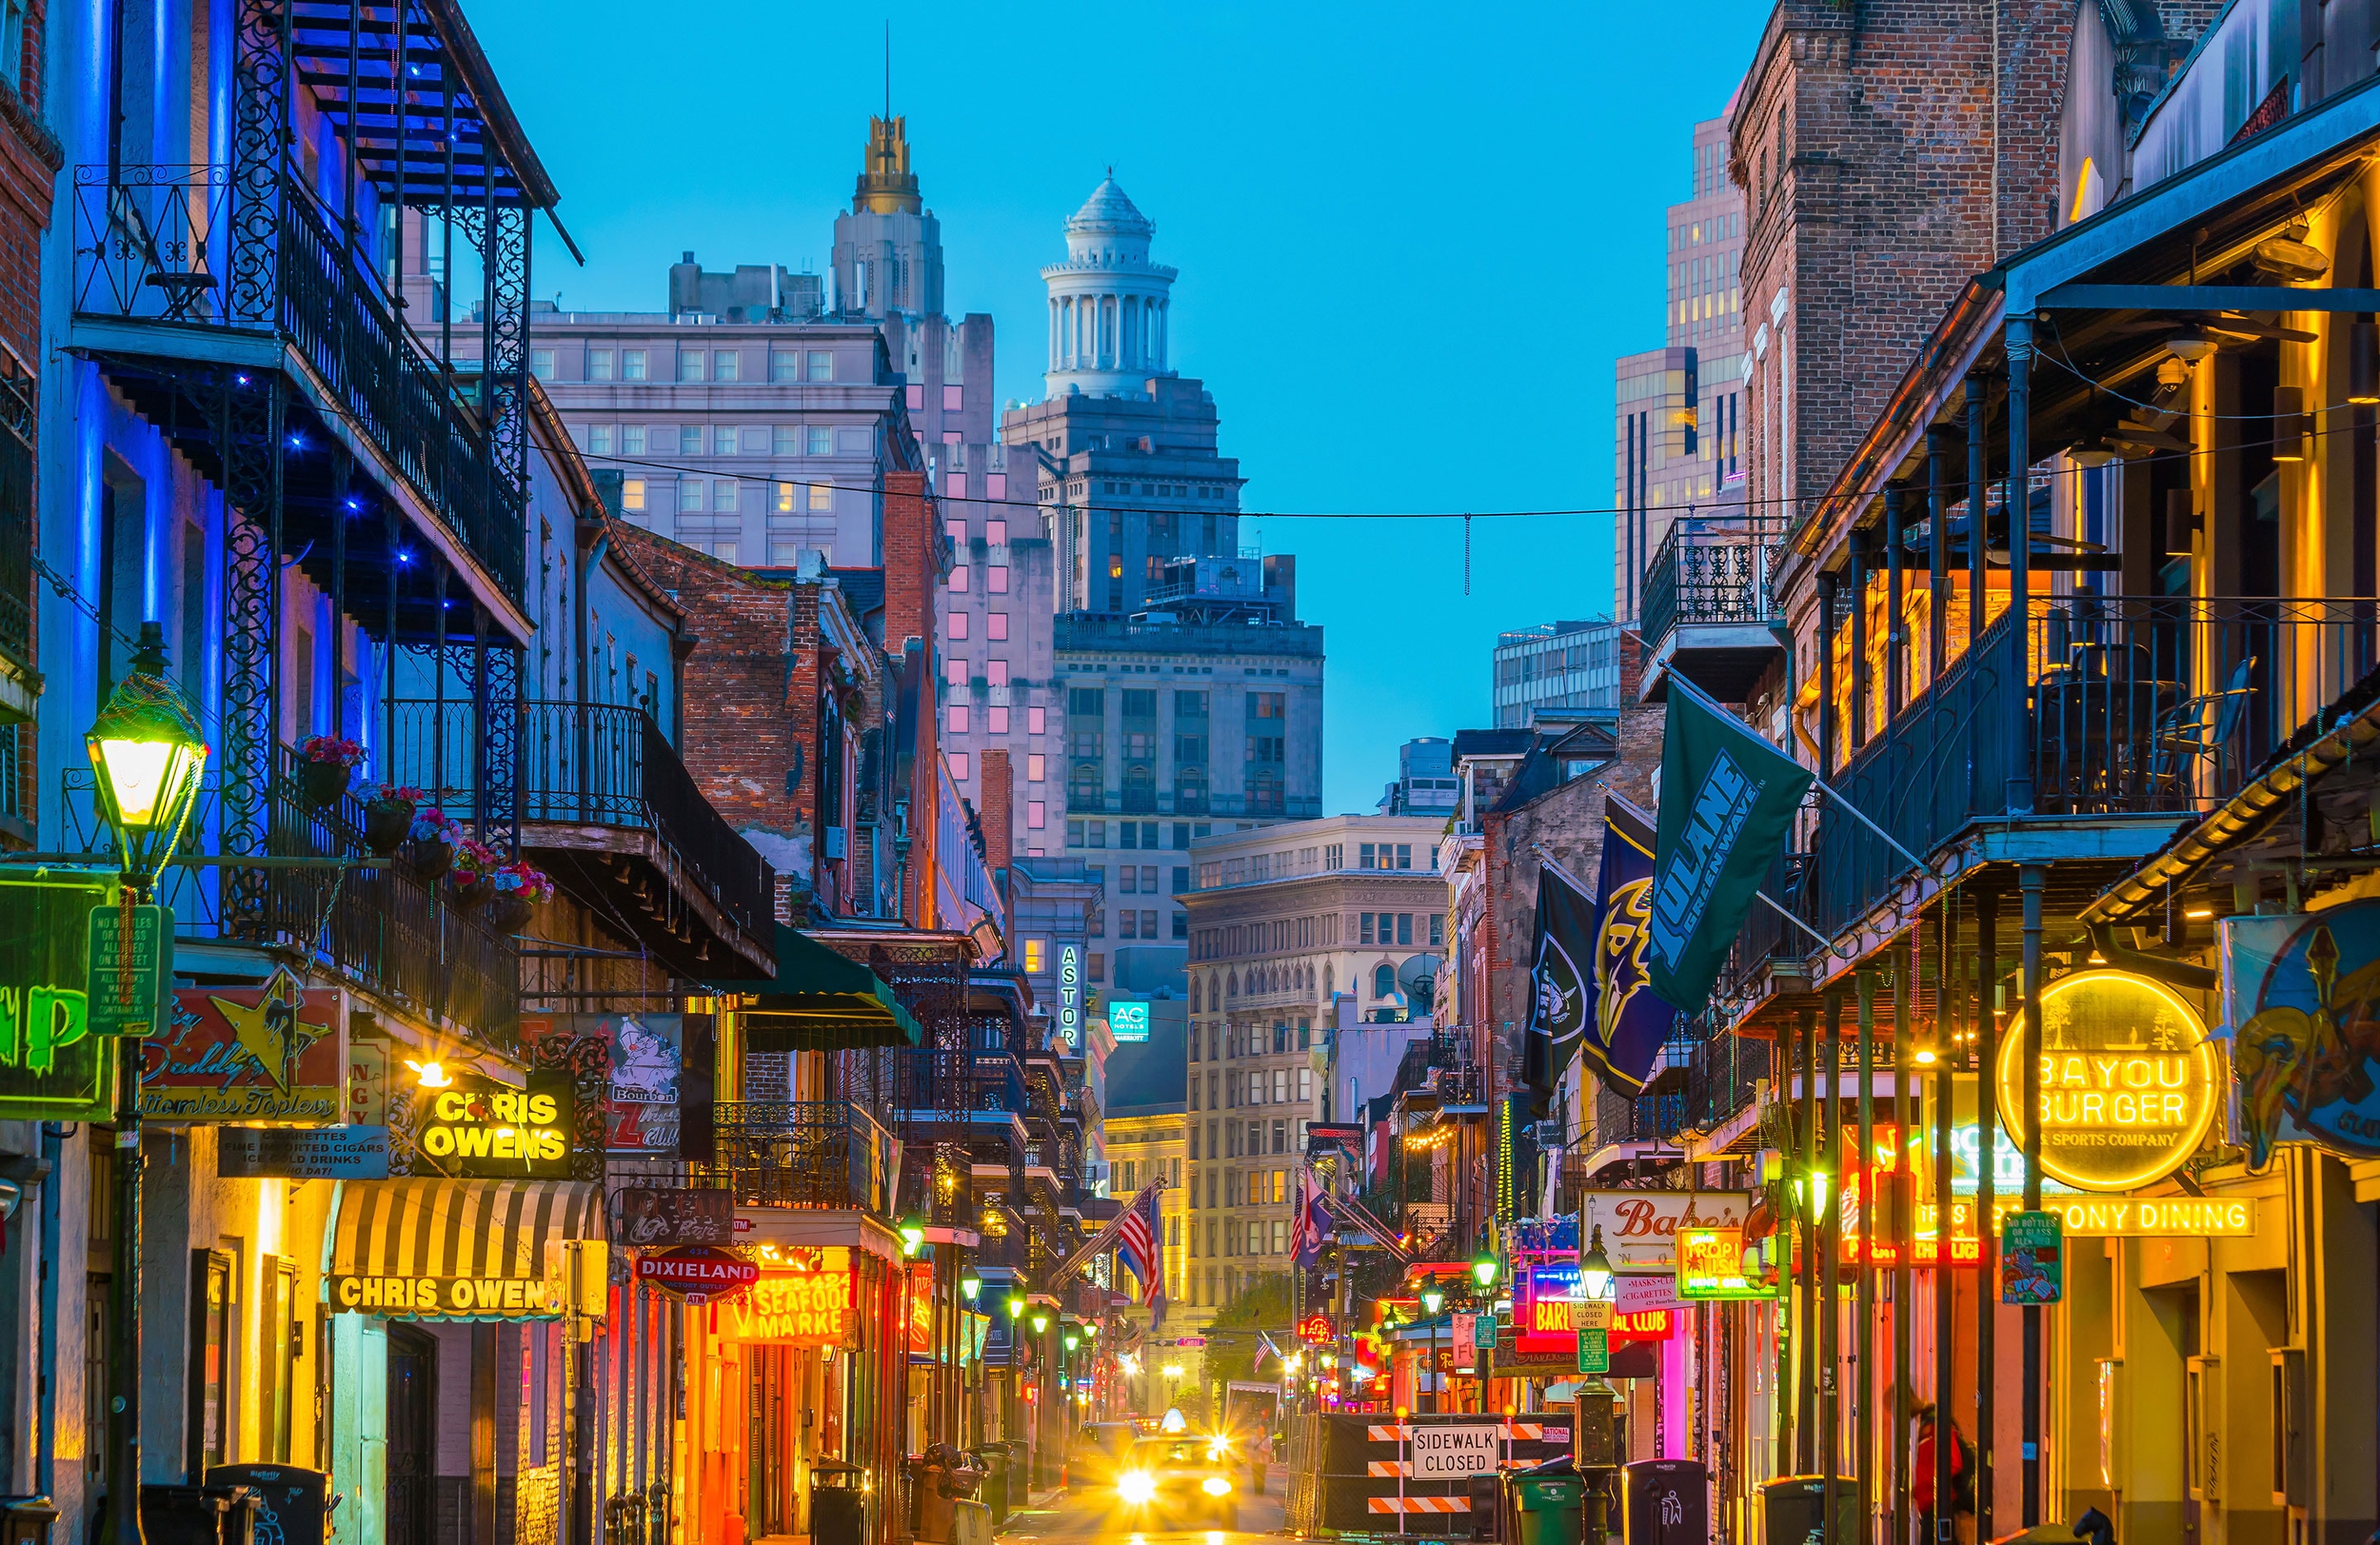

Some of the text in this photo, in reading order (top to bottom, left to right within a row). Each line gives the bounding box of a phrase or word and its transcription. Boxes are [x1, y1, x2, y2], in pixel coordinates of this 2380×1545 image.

[1683, 786, 1756, 934] GREEN WAVE
[97, 917, 109, 928] NO
[102, 929, 113, 940] OR
[1062, 946, 1076, 1047] ASTOR
[1115, 1007, 1144, 1023] AC
[616, 1089, 674, 1102] Bourbon
[140, 1089, 338, 1118] ttomless Topless
[424, 1126, 565, 1160] OWENS
[2053, 1133, 2106, 1147] SPORTS
[2108, 1132, 2178, 1147] COMPANY
[224, 1143, 255, 1153] FINE
[333, 1144, 384, 1153] CIGARS
[310, 1156, 361, 1164] DRINKS
[2007, 1218, 2057, 1228] NO BOTTLES
[2140, 1203, 2246, 1229] DINING
[2012, 1229, 2023, 1237] OR
[1685, 1242, 1739, 1257] TROPI
[642, 1261, 756, 1280] DIXIELAND
[1711, 1257, 1739, 1273] ISL
[664, 1281, 697, 1290] FACTORY
[1630, 1278, 1657, 1288] MASKS
[340, 1276, 438, 1307] CHRIS
[451, 1278, 545, 1309] OWEN
[687, 1295, 706, 1305] ATM
[1626, 1288, 1673, 1301] CIGARETTES
[758, 1310, 843, 1338] MARKE
[1633, 1310, 1667, 1332] CLUB
[1183, 1338, 1200, 1346] Canal
[1416, 1433, 1494, 1449] SIDEWALK
[1426, 1455, 1486, 1471] CLOSED
